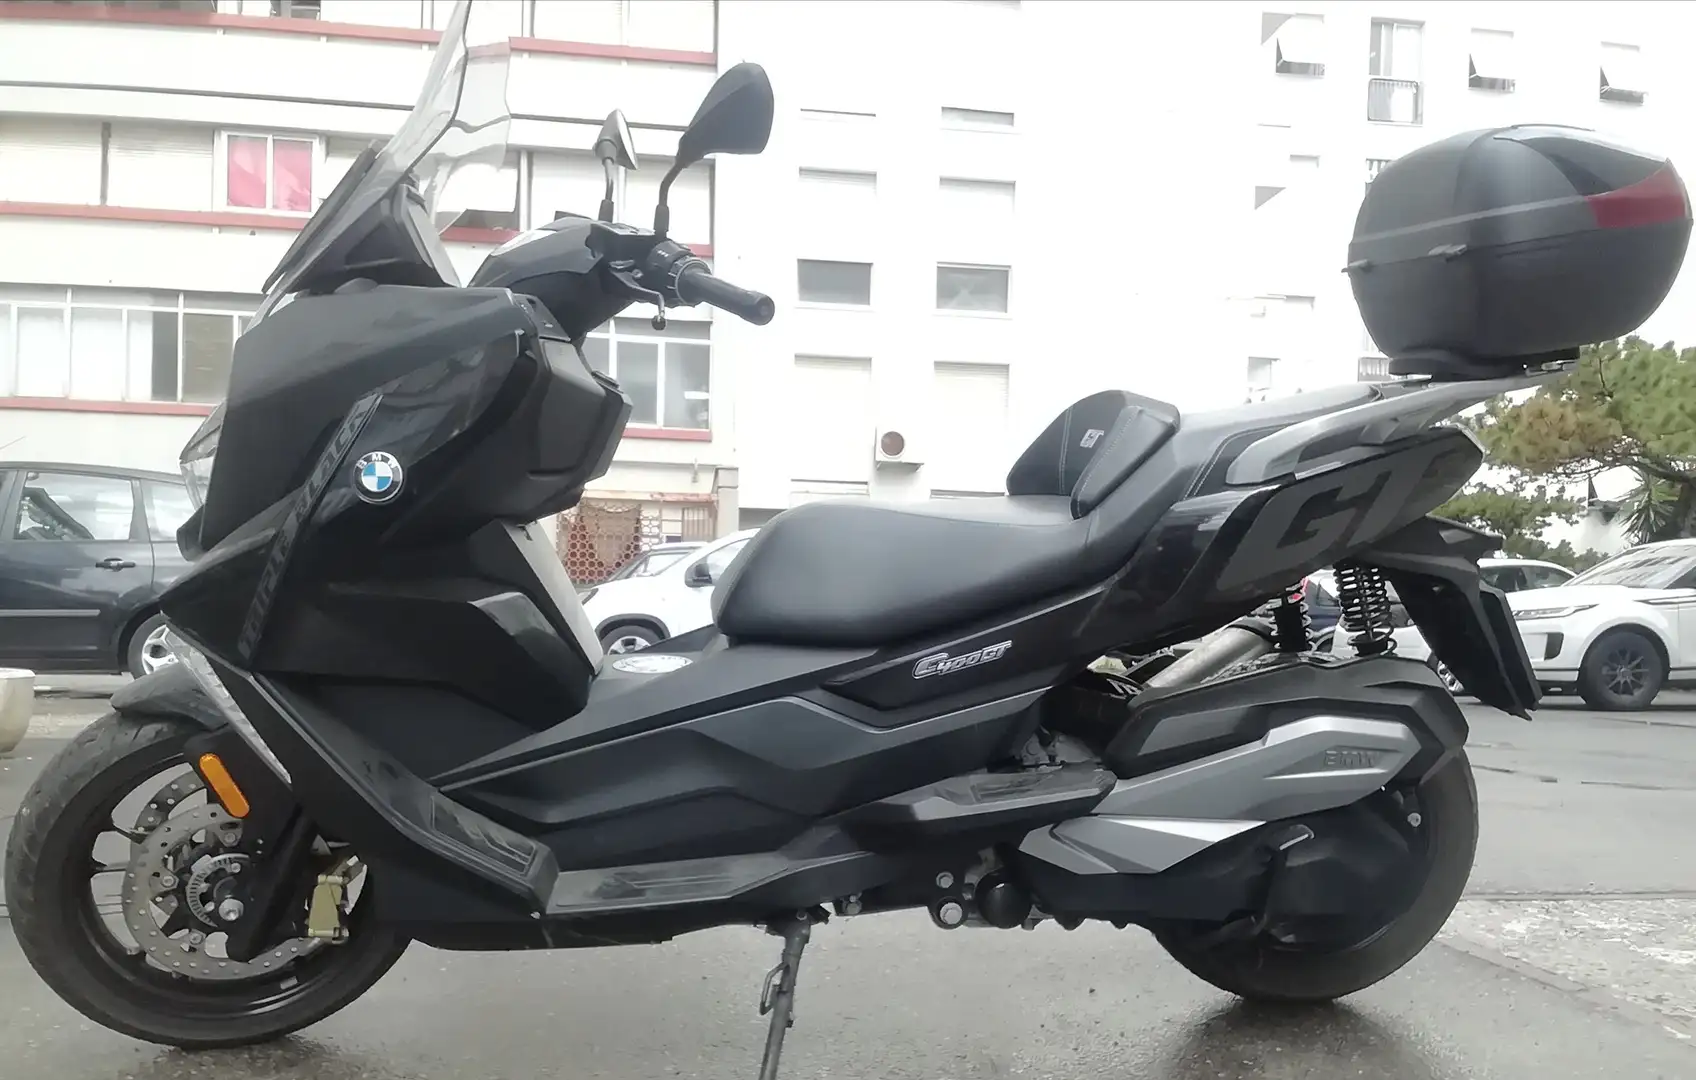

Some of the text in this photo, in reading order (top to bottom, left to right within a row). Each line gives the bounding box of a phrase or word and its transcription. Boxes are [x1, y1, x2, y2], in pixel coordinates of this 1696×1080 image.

[1080, 429, 1104, 448] GT
[1216, 434, 1464, 591] GT
[1324, 750, 1379, 769] BMW
